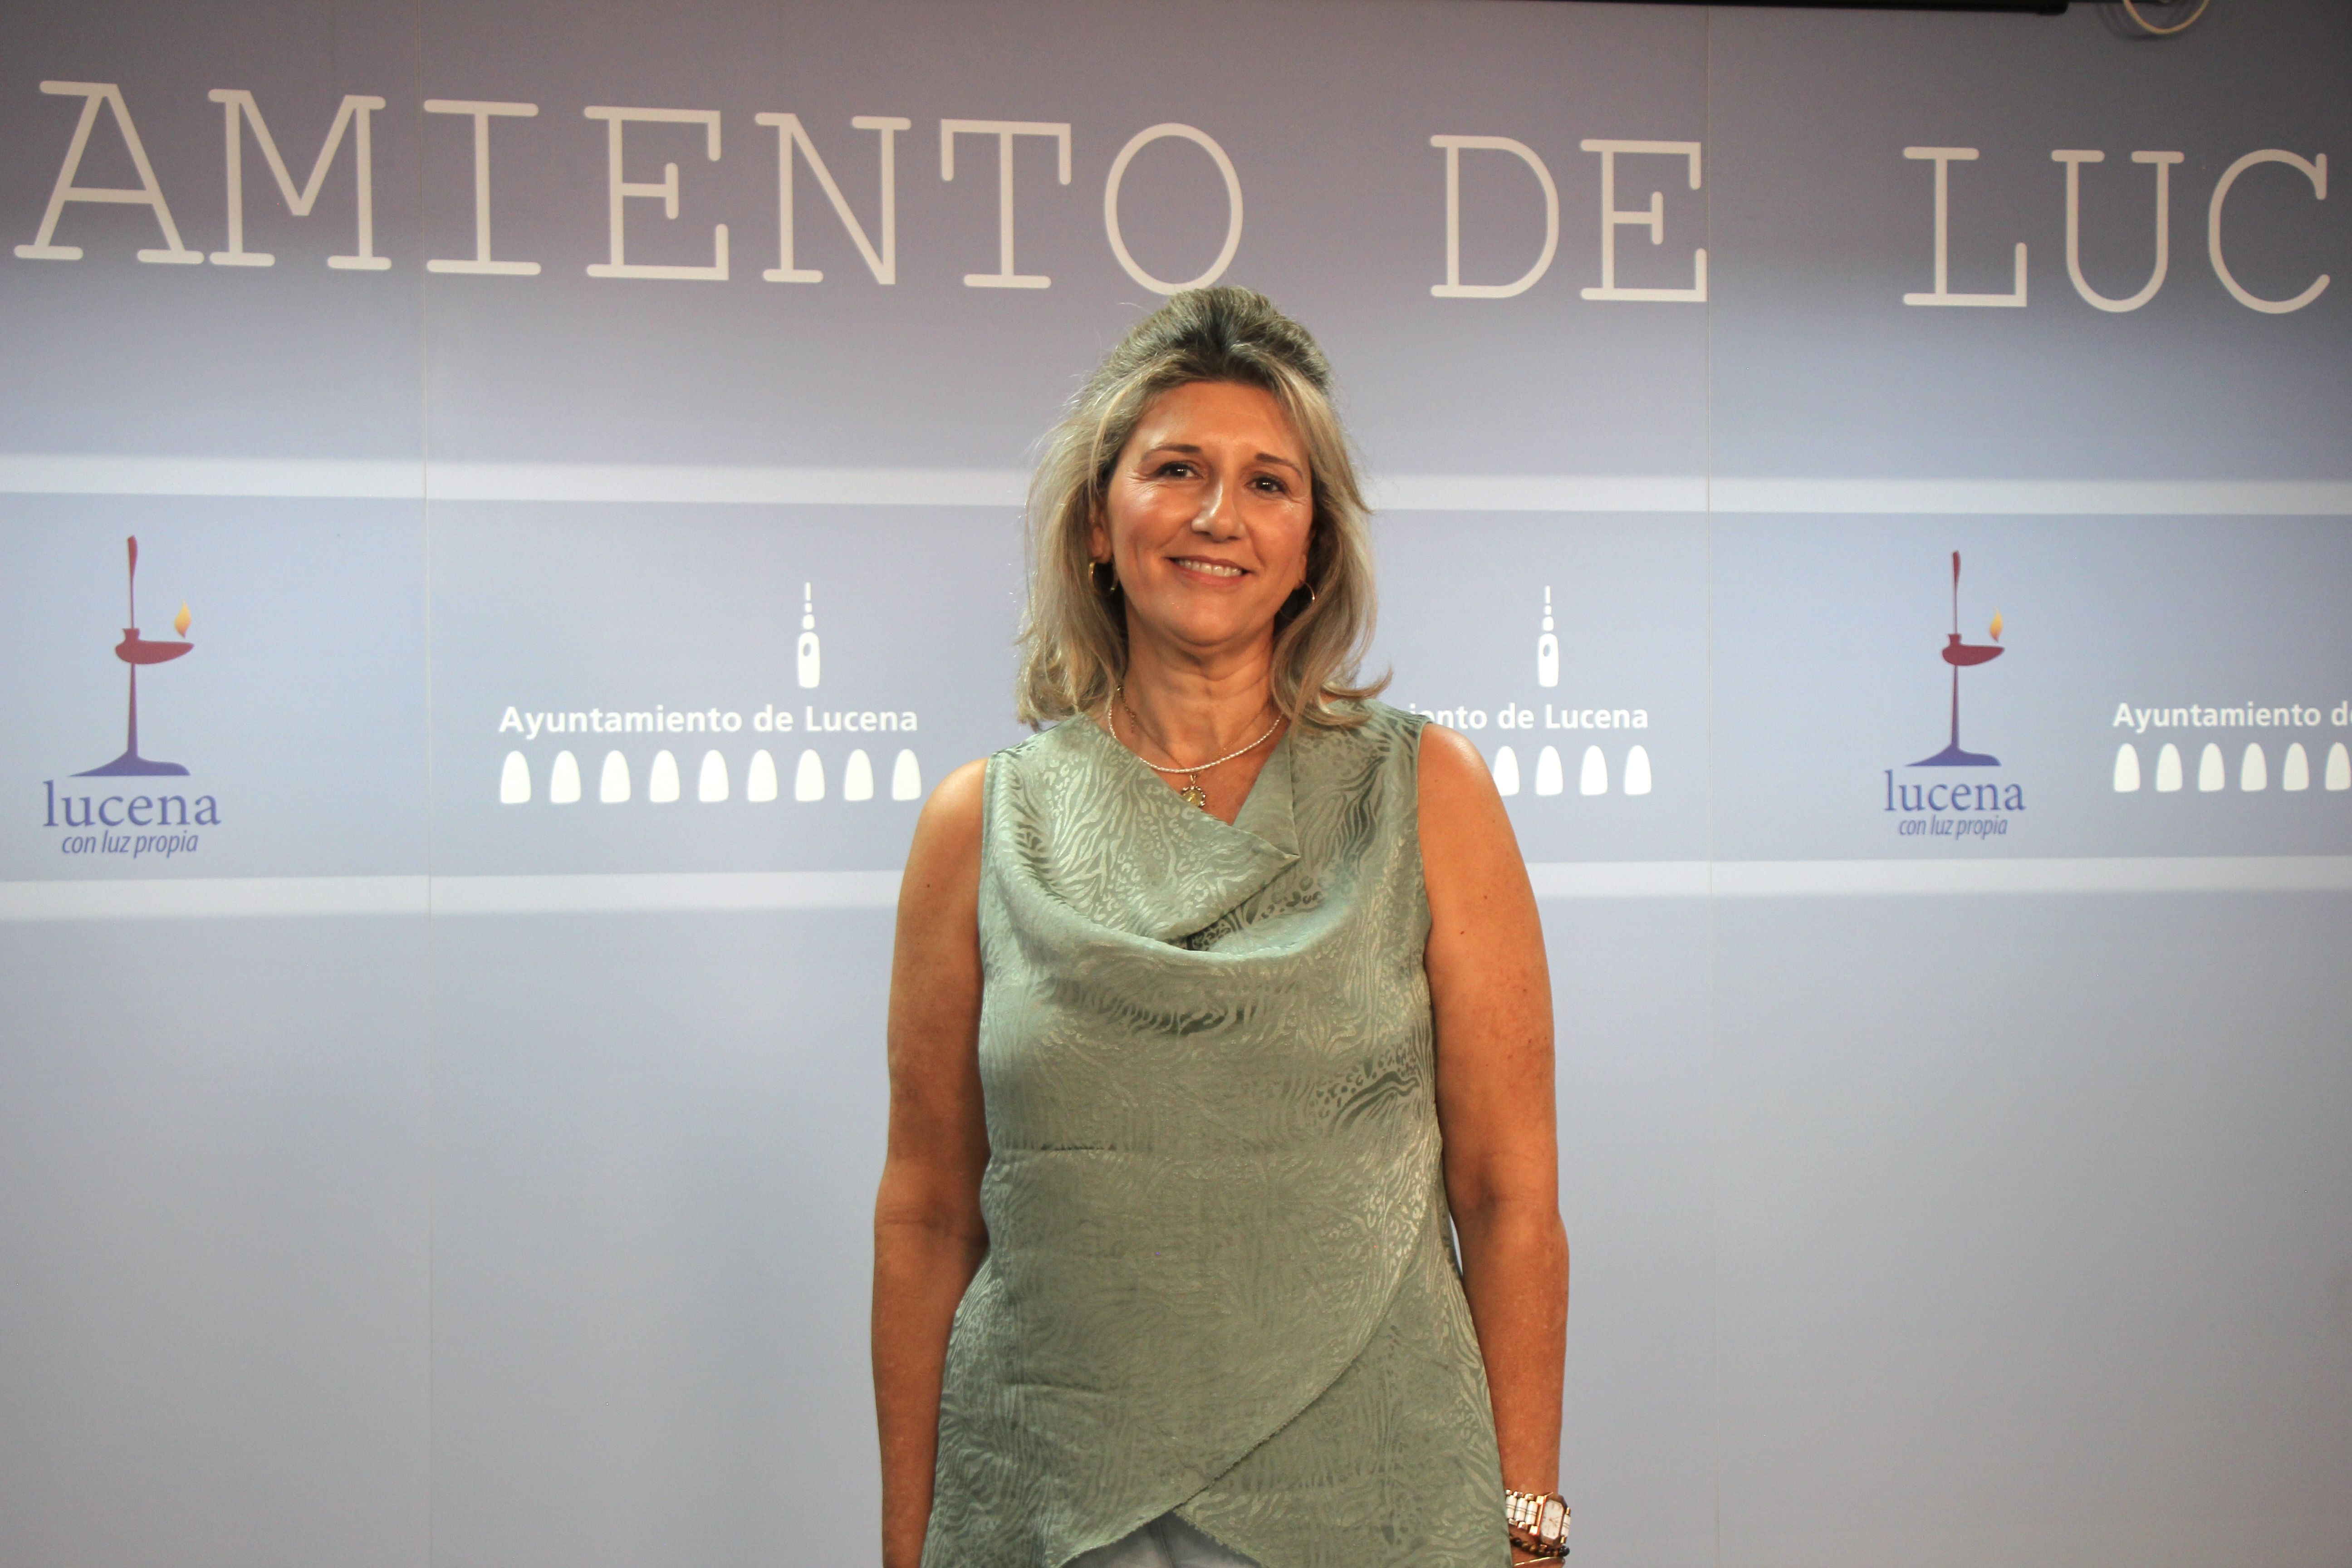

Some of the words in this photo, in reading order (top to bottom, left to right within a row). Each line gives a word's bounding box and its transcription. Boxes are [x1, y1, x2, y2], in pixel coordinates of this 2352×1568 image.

[14, 80, 1243, 295] AMIENTO
[1430, 135, 1708, 303] DE
[1902, 147, 2331, 314] LUC
[499, 705, 742, 740] Ayuntamiento
[753, 704, 794, 732] de
[806, 706, 919, 732] Lucena
[1498, 702, 1534, 729] de
[1546, 704, 1648, 729] Lucena
[2112, 701, 2322, 733] Ayuntamiento
[2331, 700, 2352, 726] d
[43, 779, 222, 827] lucena
[1884, 769, 2027, 811] lucena
[1899, 819, 1927, 835] con
[1930, 814, 1954, 835] luz
[1956, 815, 2009, 840] propia
[62, 834, 97, 854] con
[101, 830, 130, 853] luz
[133, 830, 199, 859] propia
